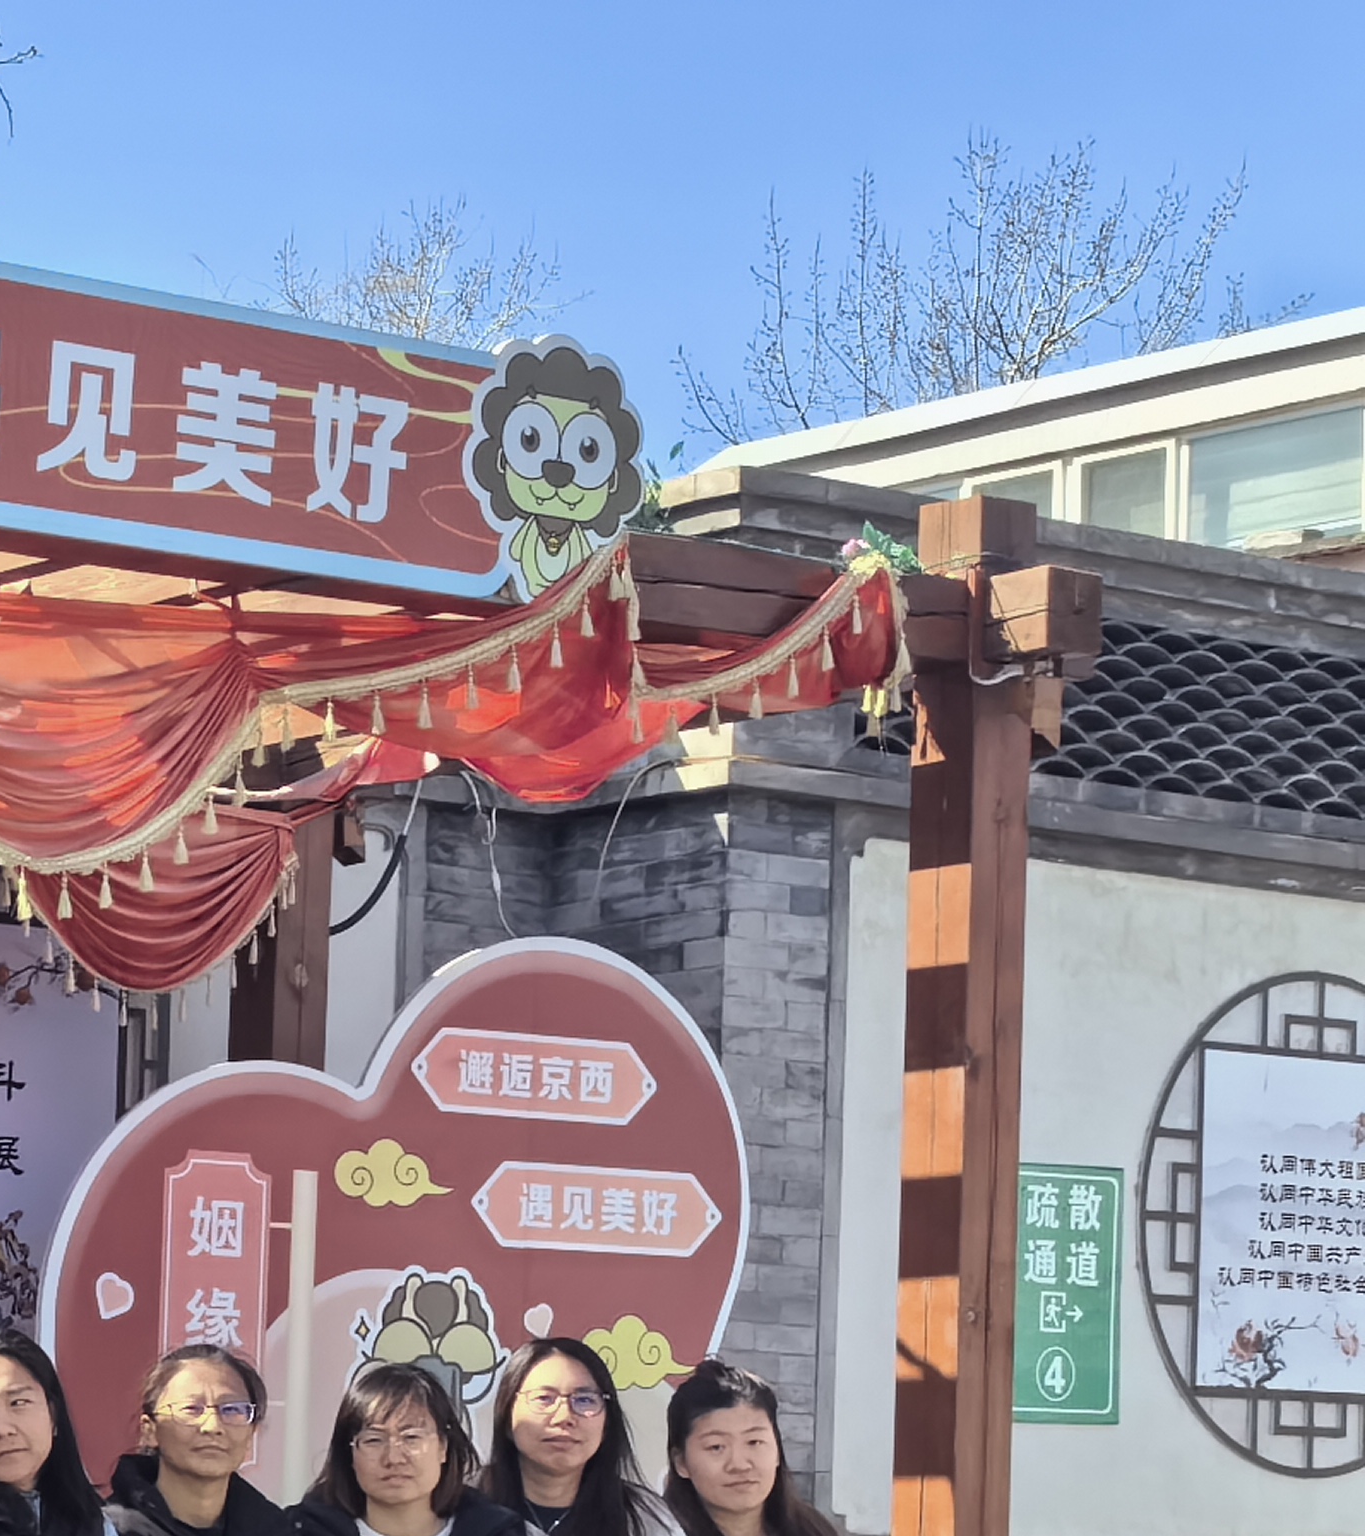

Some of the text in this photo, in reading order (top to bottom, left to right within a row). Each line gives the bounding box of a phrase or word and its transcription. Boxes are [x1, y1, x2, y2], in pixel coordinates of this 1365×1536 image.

[457, 1049, 615, 1104] 邂逅京西
[519, 1183, 678, 1236] 遇见美好
[1026, 1183, 1103, 1231] 疏散
[184, 1196, 245, 1348] 姻缘
[1024, 1240, 1100, 1287] 通道
[1248, 1239, 1365, 1266] 认同中国共产
[1044, 1355, 1066, 1394] 4
